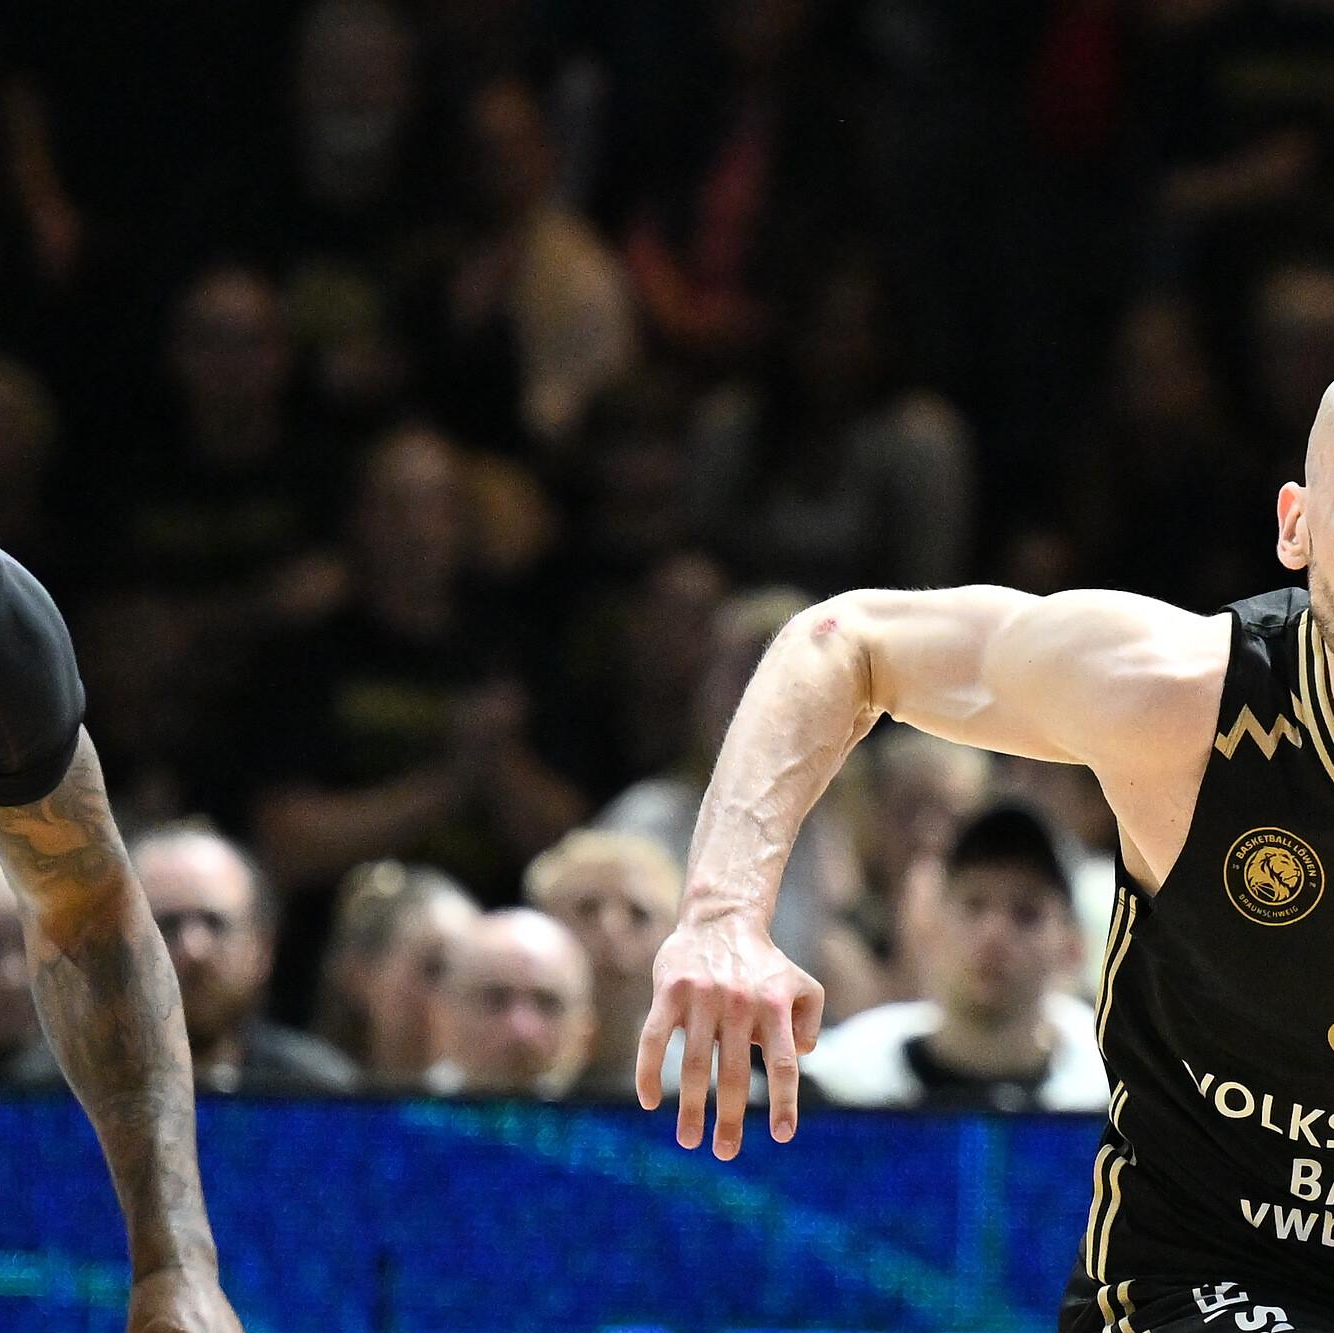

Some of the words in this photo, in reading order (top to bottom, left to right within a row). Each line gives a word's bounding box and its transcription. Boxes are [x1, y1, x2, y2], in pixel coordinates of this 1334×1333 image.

[1235, 834, 1293, 860] BASKETBALL
[1293, 844, 1318, 877] LÖWEN
[1238, 893, 1299, 918] BRAUNSCHWEIG
